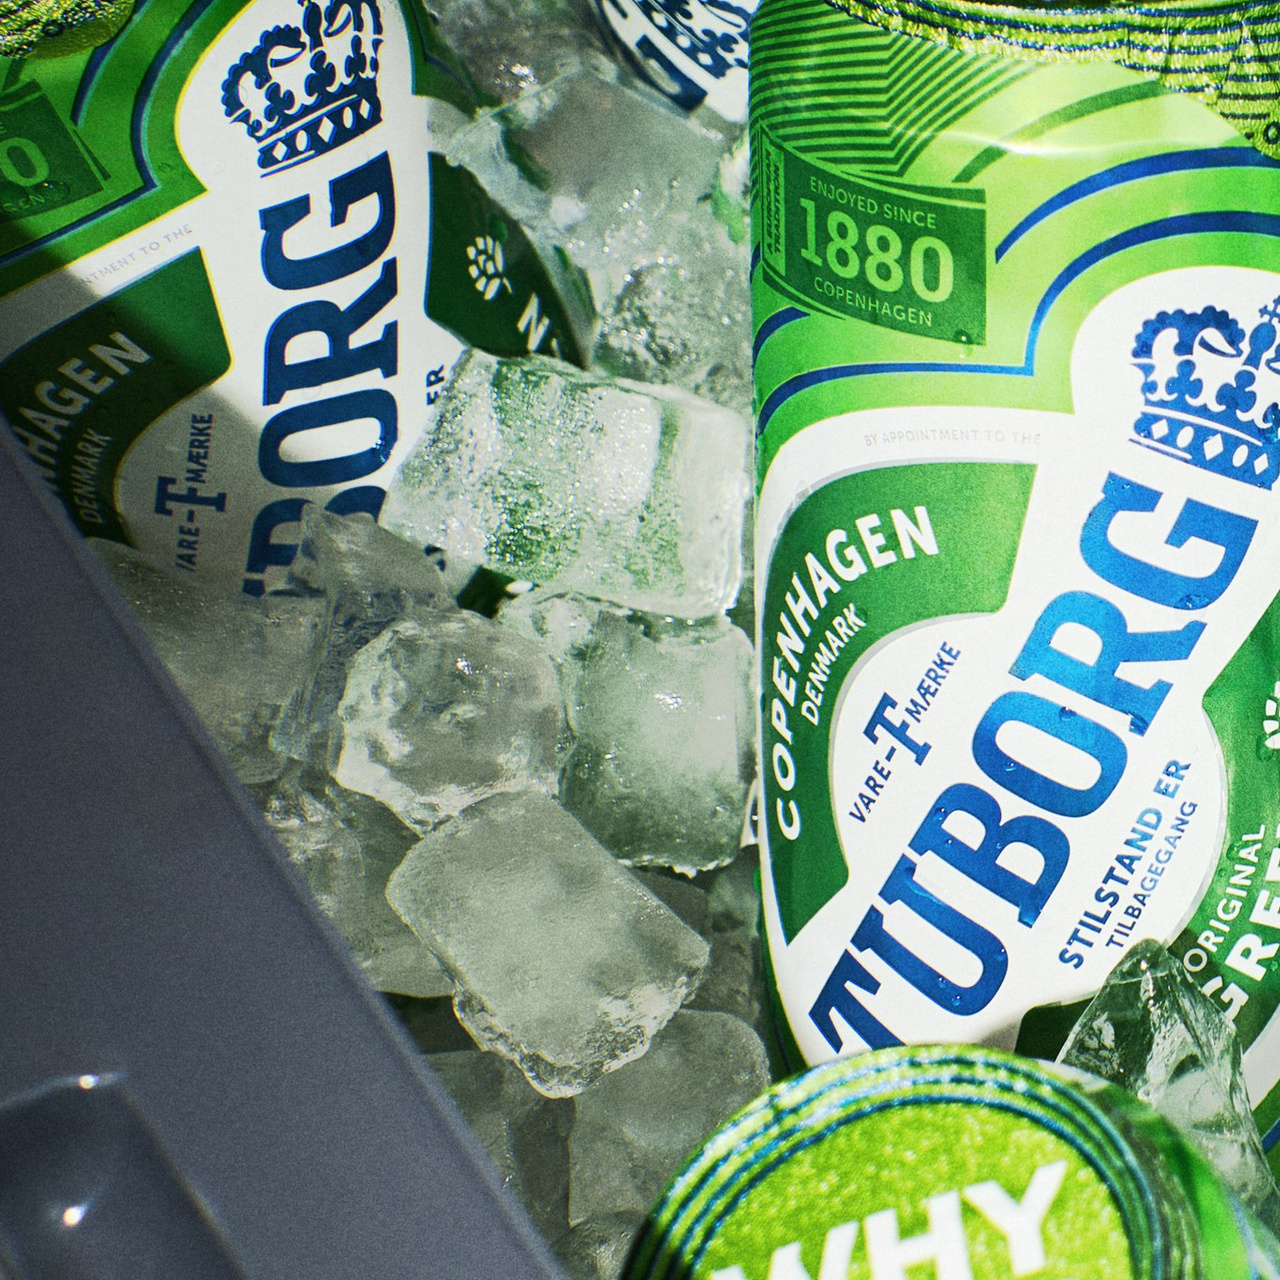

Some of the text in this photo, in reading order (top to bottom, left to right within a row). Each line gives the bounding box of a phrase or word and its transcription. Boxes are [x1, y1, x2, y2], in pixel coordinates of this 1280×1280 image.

[139, 241, 162, 257] TO
[163, 224, 194, 244] THE
[800, 197, 954, 303] 1880
[810, 176, 937, 229] ENJOYED SINCE
[813, 277, 932, 327] COPENHAGEN
[12, 331, 153, 491] HAGEN
[882, 428, 979, 444] APPOINTMENT
[985, 430, 1006, 444] TO
[1012, 431, 1042, 445] THE
[73, 428, 113, 523] DENMARK
[771, 505, 941, 841] COPENHAGEN
[801, 602, 867, 726] DENMARK
[808, 471, 1259, 1054] TUBORG
[1059, 759, 1192, 970] STILSTAND ER
[1105, 800, 1198, 949] TILBAGEGANG
[1183, 824, 1266, 972] ORIGINAL
